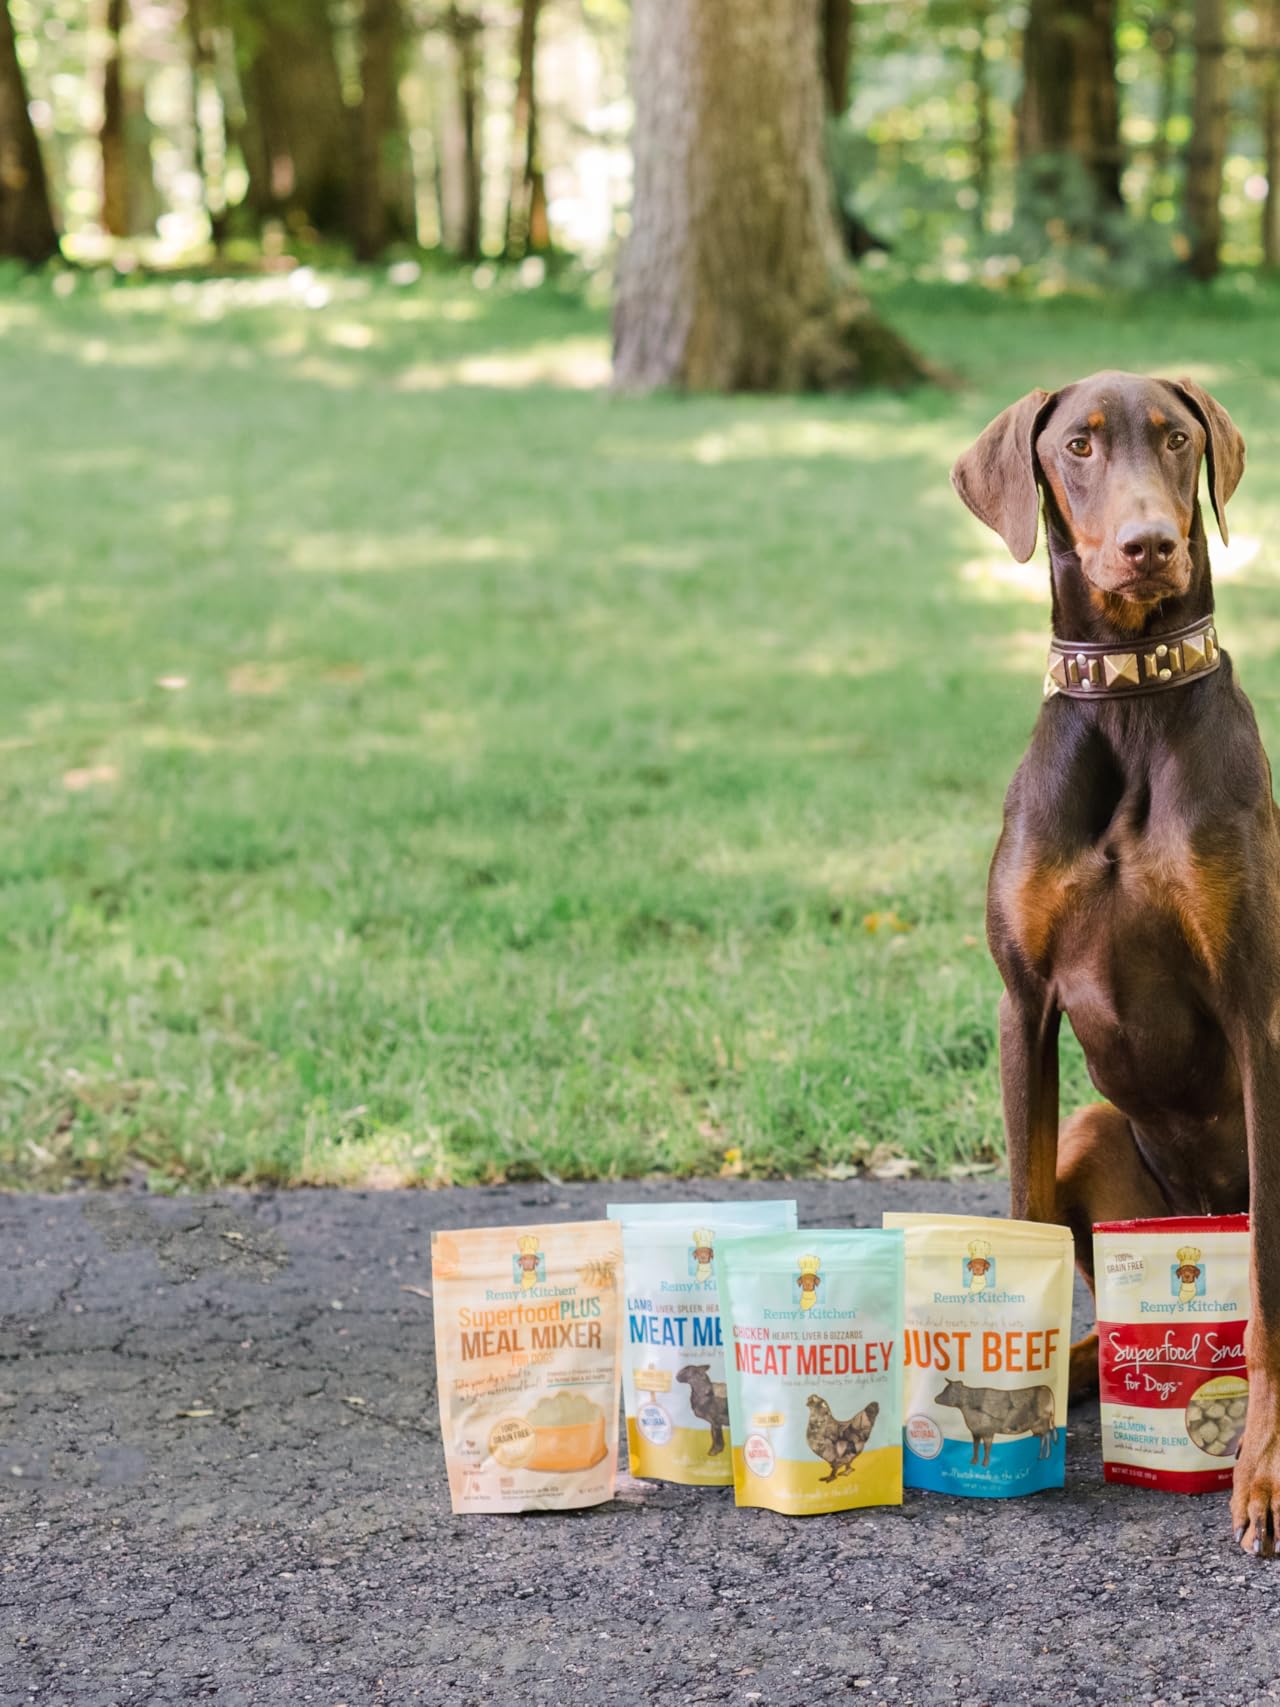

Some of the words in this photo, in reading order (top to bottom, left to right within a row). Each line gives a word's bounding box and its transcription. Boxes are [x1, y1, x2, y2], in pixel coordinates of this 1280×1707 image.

[1127, 1260, 1144, 1271] FREE
[530, 1285, 577, 1298] Kitchen
[660, 1280, 700, 1293] Remy's
[627, 1298, 653, 1312] LAMB
[933, 1292, 975, 1304] Remy's
[978, 1291, 1025, 1303] Kitchen
[763, 1308, 805, 1321] Remy's
[808, 1307, 856, 1319] Kitchen
[1140, 1301, 1184, 1314] Remy's
[1187, 1301, 1237, 1312] Kitchen
[629, 1314, 687, 1346] MEAT
[733, 1325, 769, 1340] CHICKEN
[802, 1331, 822, 1341] LIVER
[460, 1328, 525, 1362] MEAL
[531, 1320, 602, 1350] MIXER
[904, 1328, 971, 1372] JUST
[982, 1328, 1060, 1372] BEEF
[1108, 1330, 1201, 1375] Superfood
[1205, 1332, 1248, 1363] Sna
[734, 1342, 792, 1376] MEAT
[796, 1341, 894, 1375] MEDLEY
[1124, 1373, 1141, 1391] for
[1143, 1373, 1177, 1401] Dogs
[1113, 1420, 1147, 1432] SALMON
[1113, 1431, 1158, 1446] CRANBERRY
[1161, 1437, 1189, 1447] BLEND
